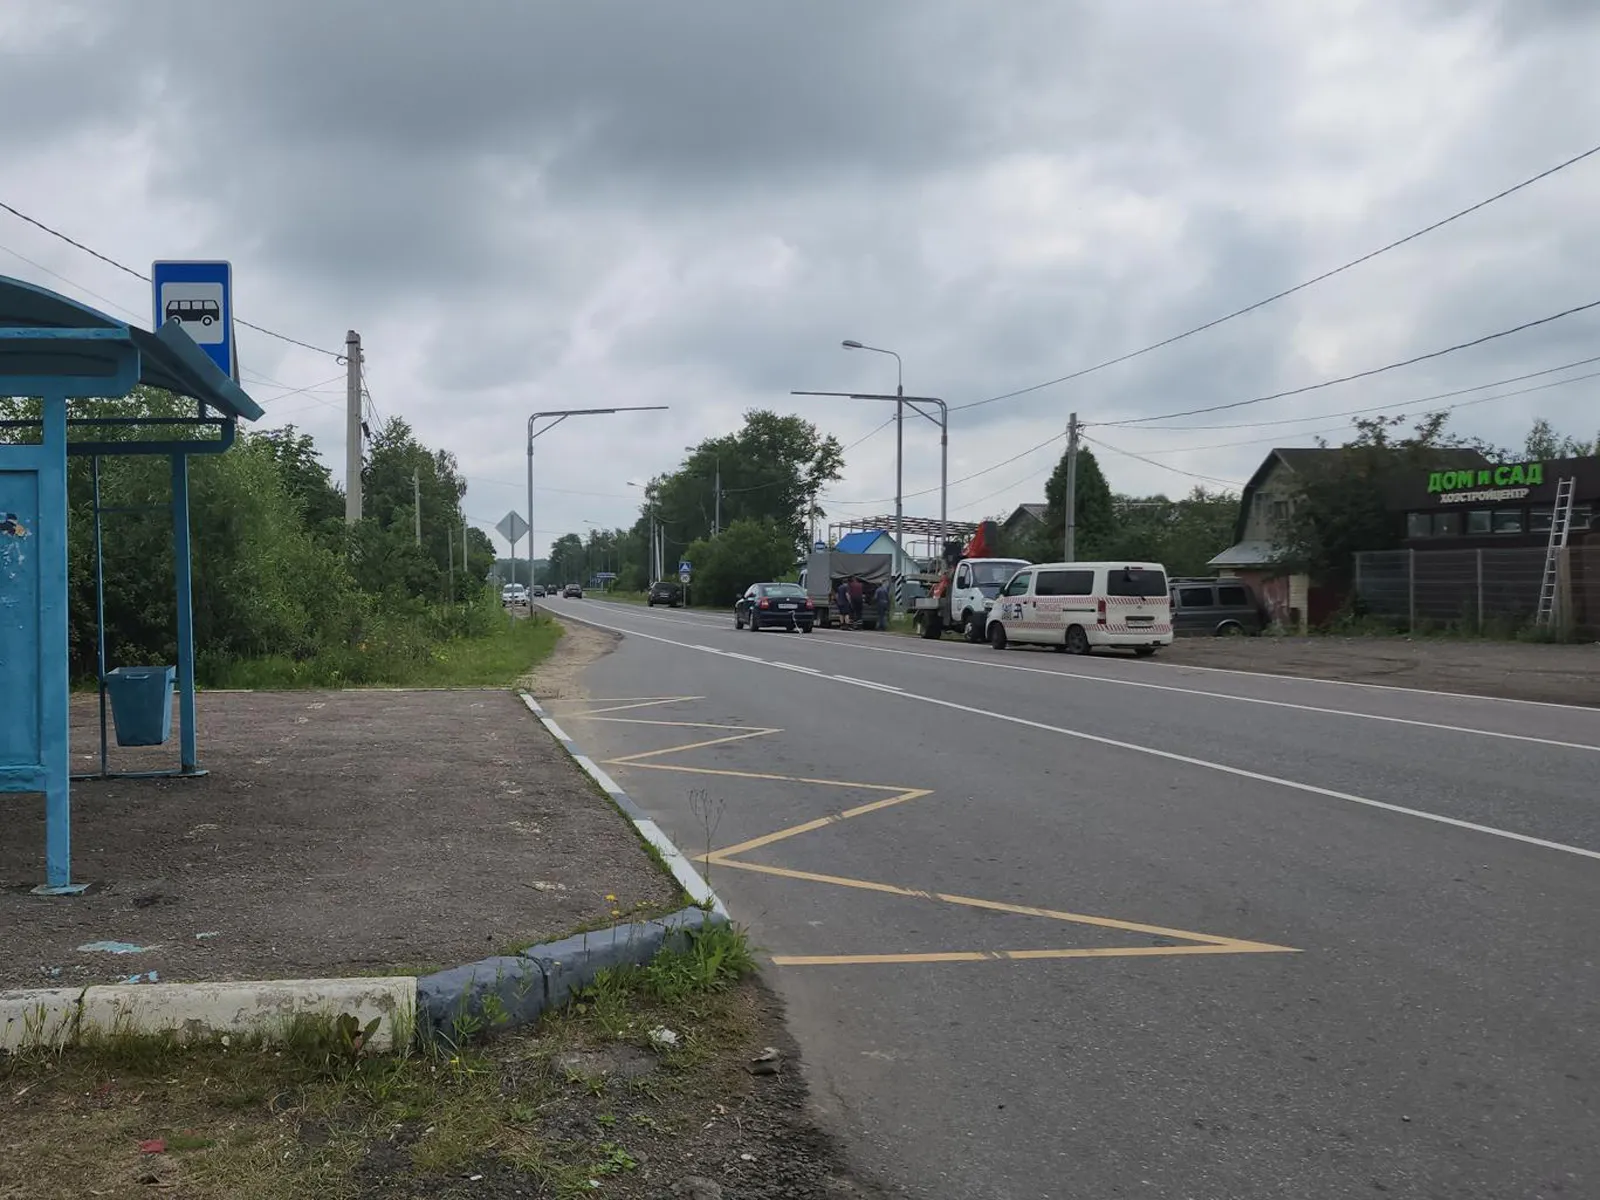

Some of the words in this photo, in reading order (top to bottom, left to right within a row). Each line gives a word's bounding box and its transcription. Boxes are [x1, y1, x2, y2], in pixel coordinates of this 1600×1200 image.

[1428, 471, 1474, 492] ДОМ
[1495, 464, 1542, 485] САД
[1440, 488, 1530, 503] ХОЗСТРОЙЦЕНТР
